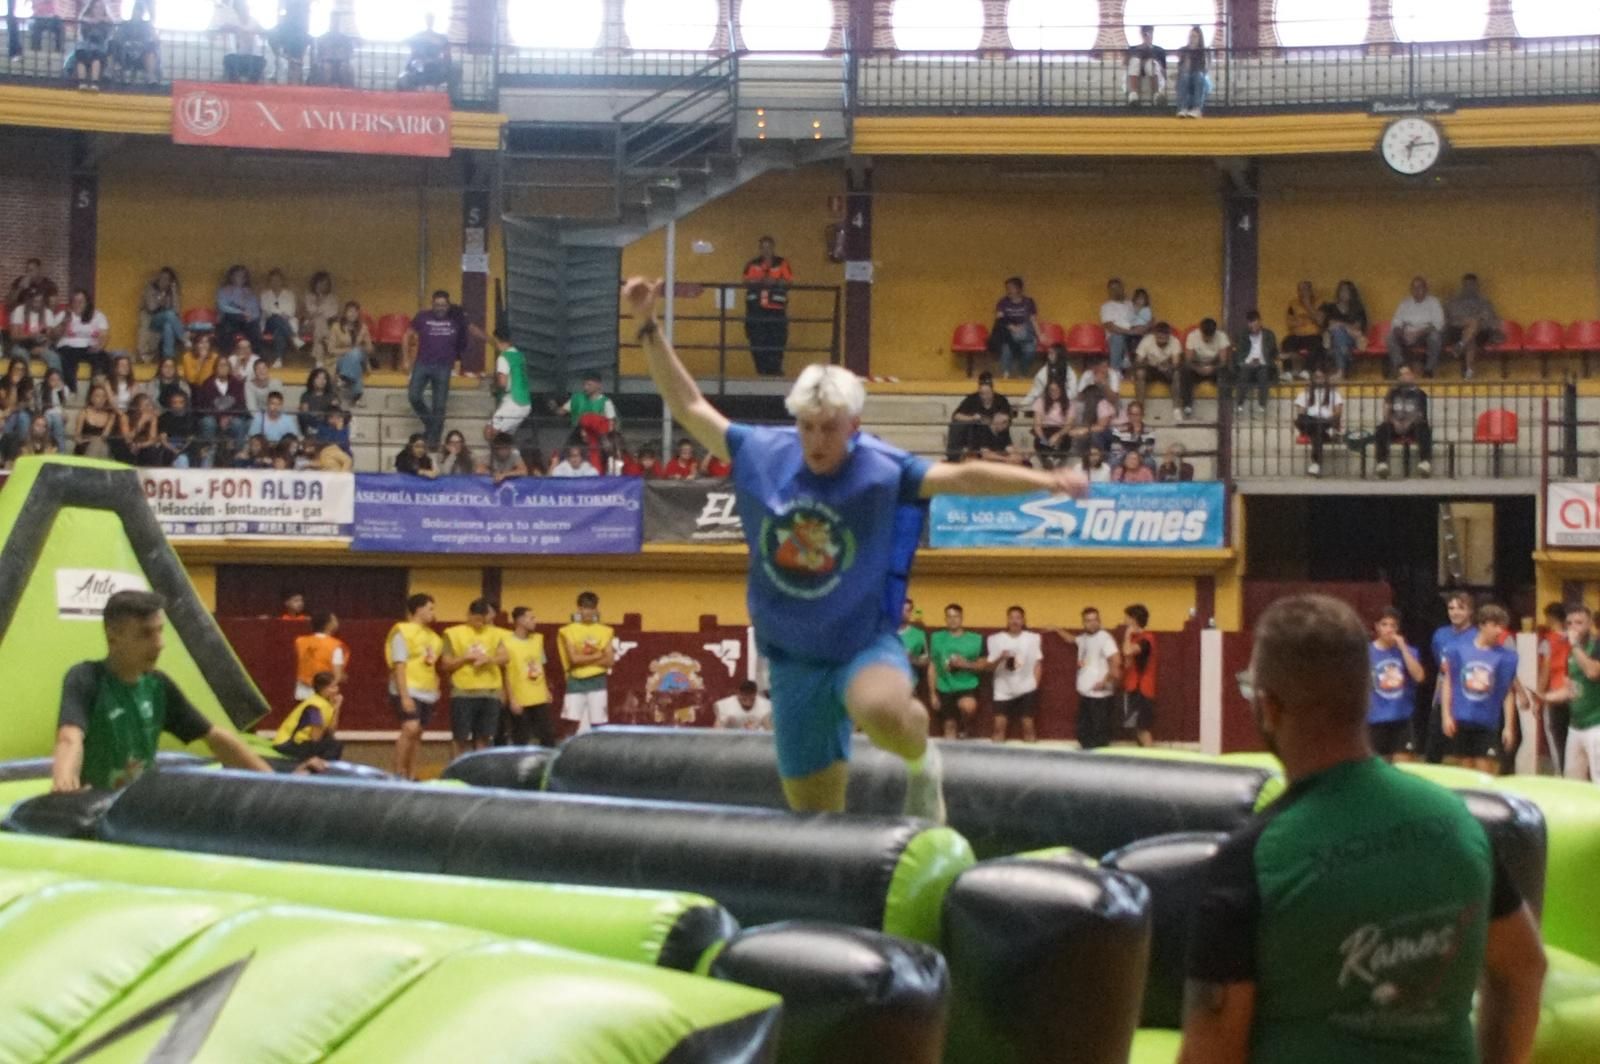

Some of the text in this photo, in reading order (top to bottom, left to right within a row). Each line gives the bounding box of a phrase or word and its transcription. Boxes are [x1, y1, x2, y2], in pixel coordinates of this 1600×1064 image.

[299, 108, 446, 135] ANIVERSARIO
[851, 211, 864, 229] 4
[1238, 214, 1251, 231] 4
[261, 479, 323, 500] ALBA
[302, 507, 322, 520] gas
[696, 492, 741, 527] EL
[1075, 499, 1208, 542] Tormes
